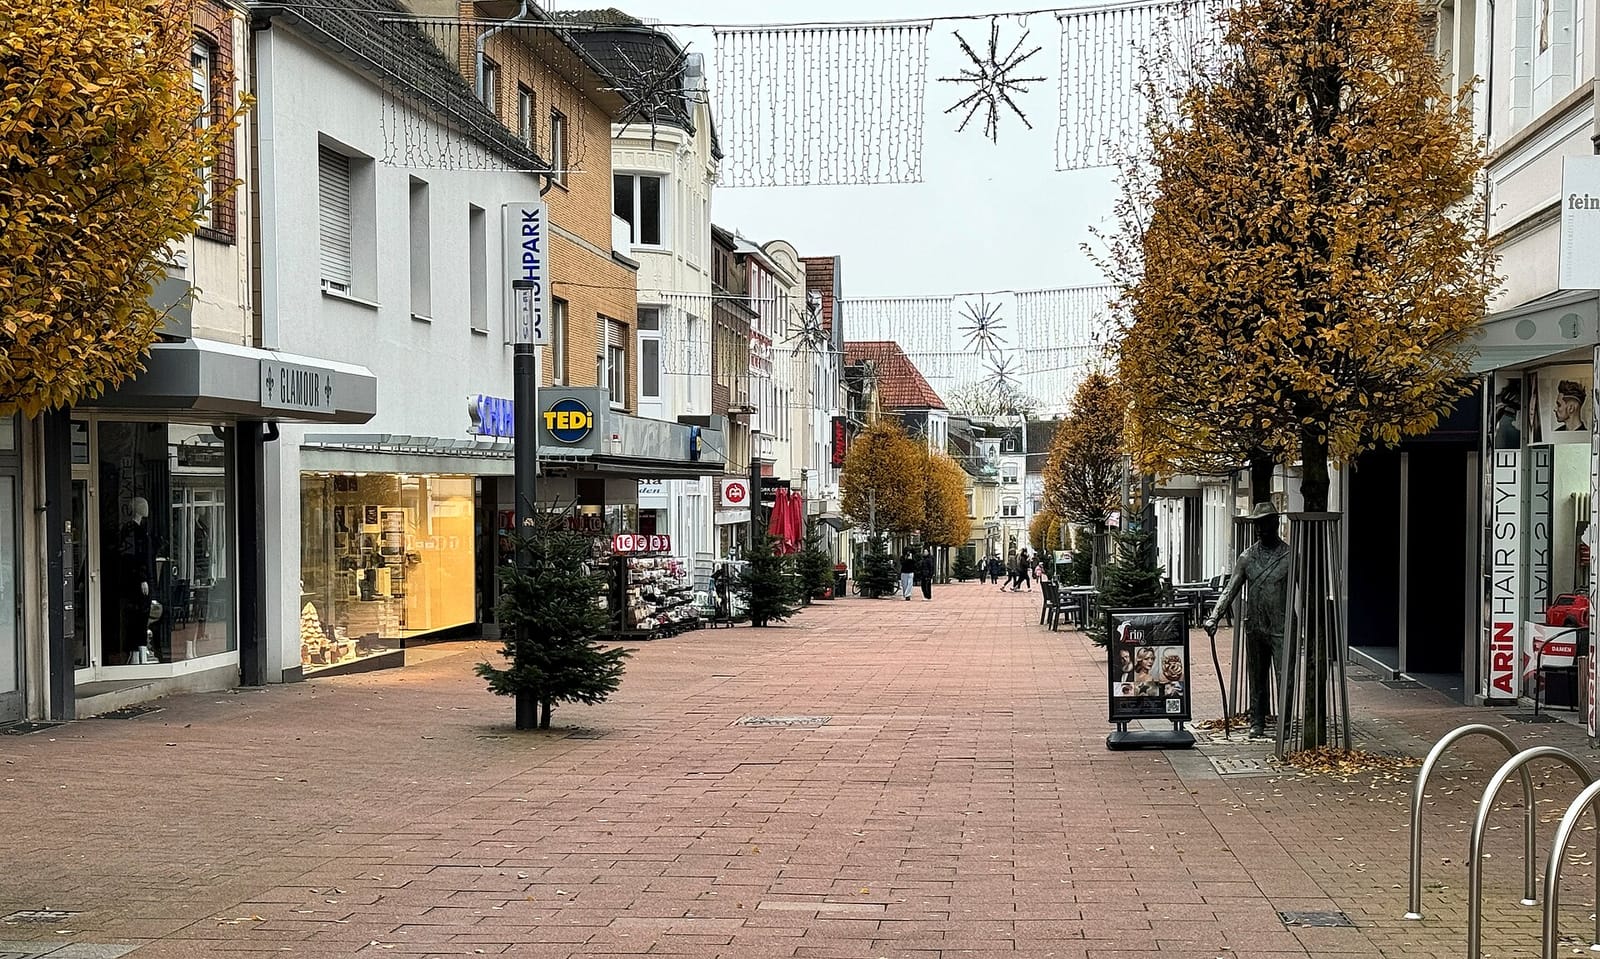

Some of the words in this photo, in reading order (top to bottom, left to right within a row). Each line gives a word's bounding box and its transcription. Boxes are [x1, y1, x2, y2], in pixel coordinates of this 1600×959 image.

[281, 367, 320, 407] GLAMOUR
[544, 411, 592, 429] TEDi
[1495, 452, 1516, 539] STYLE
[619, 536, 632, 549] 1€
[1494, 549, 1515, 614] HAIR
